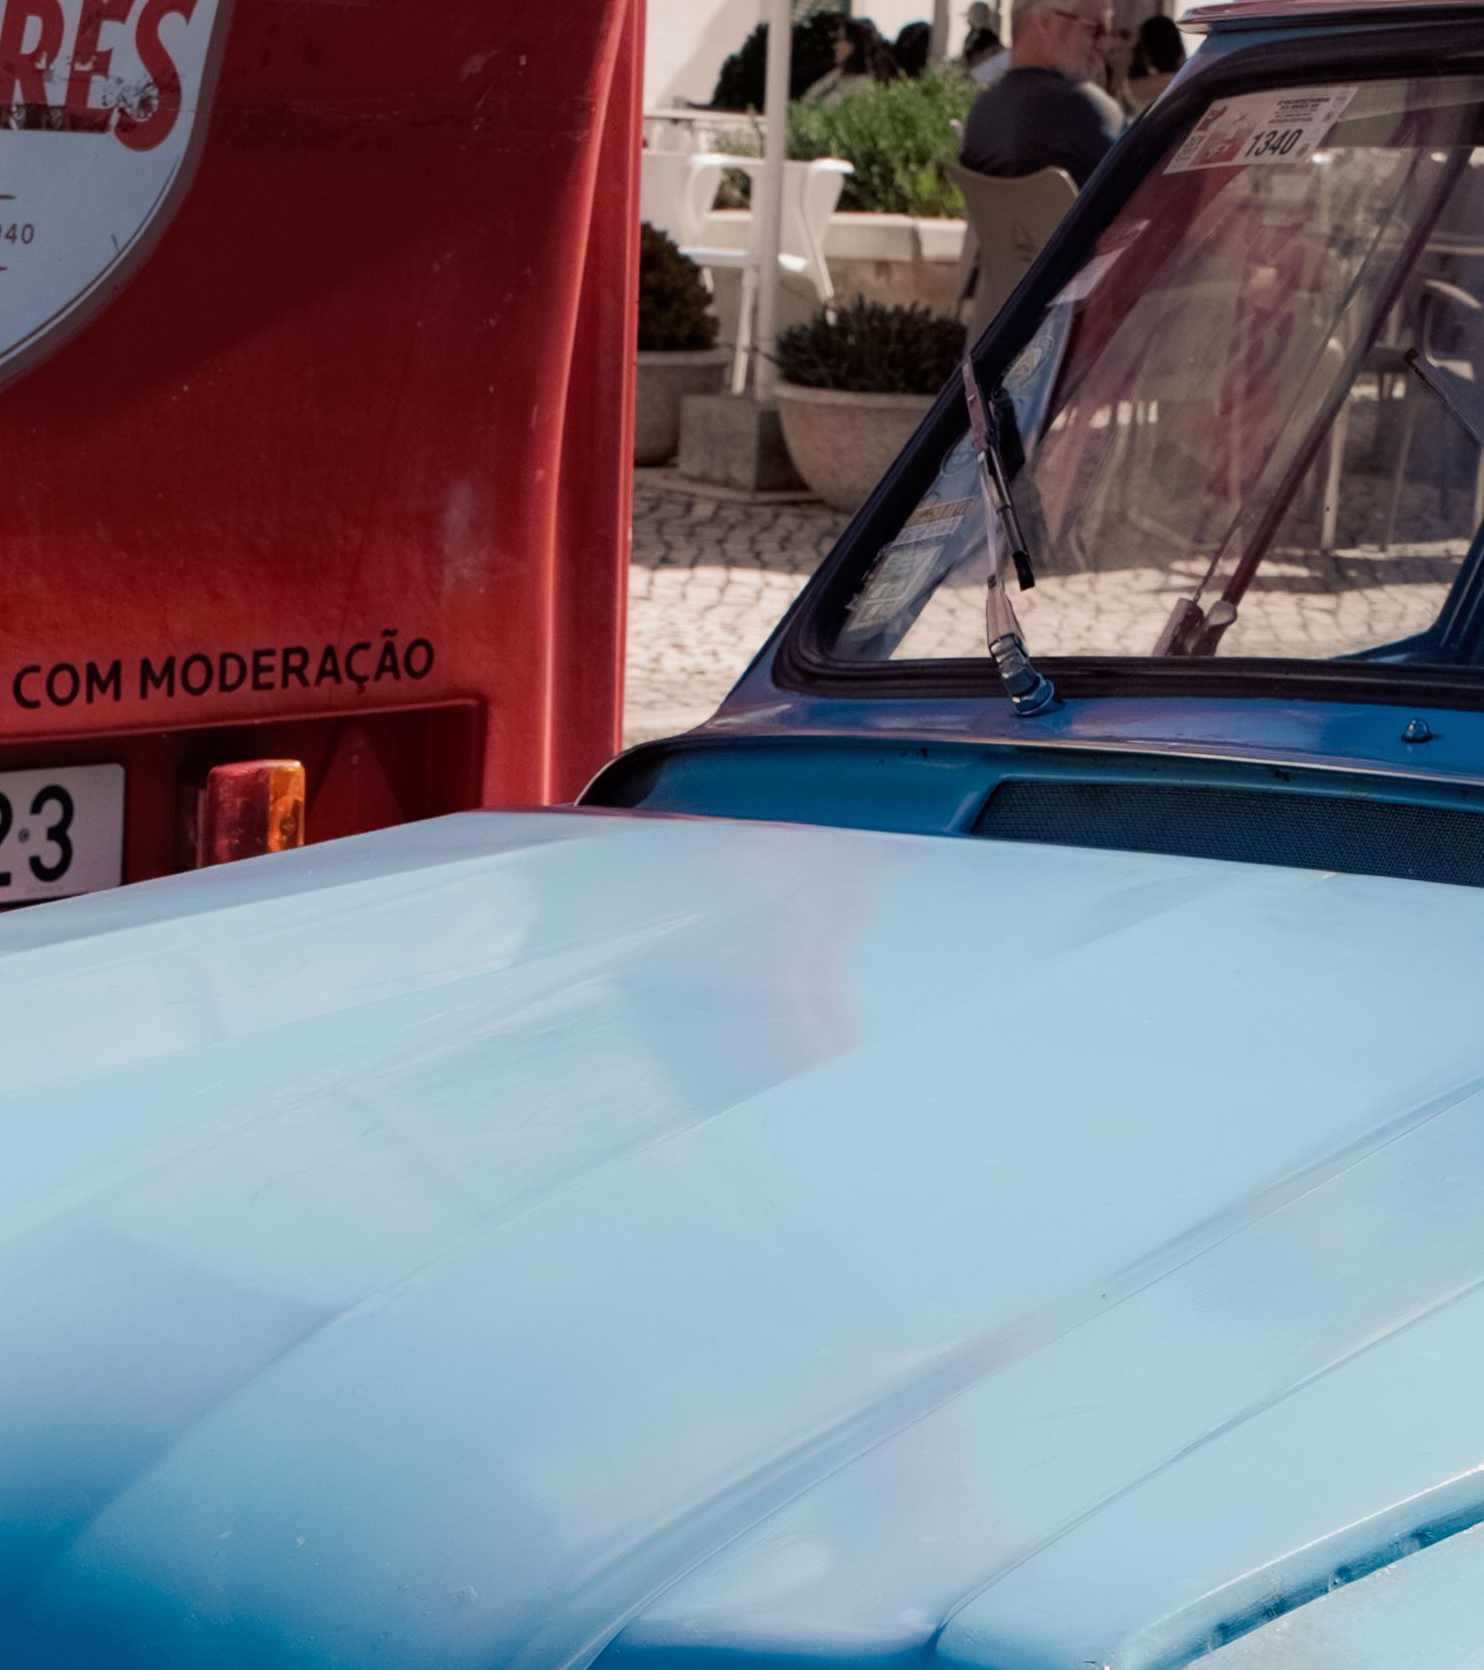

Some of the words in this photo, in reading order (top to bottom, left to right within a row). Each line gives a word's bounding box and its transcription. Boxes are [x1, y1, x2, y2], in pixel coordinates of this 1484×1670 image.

[1244, 128, 1304, 158] 1340
[10, 657, 124, 713] COM
[137, 627, 437, 700] MODERAÇÃO
